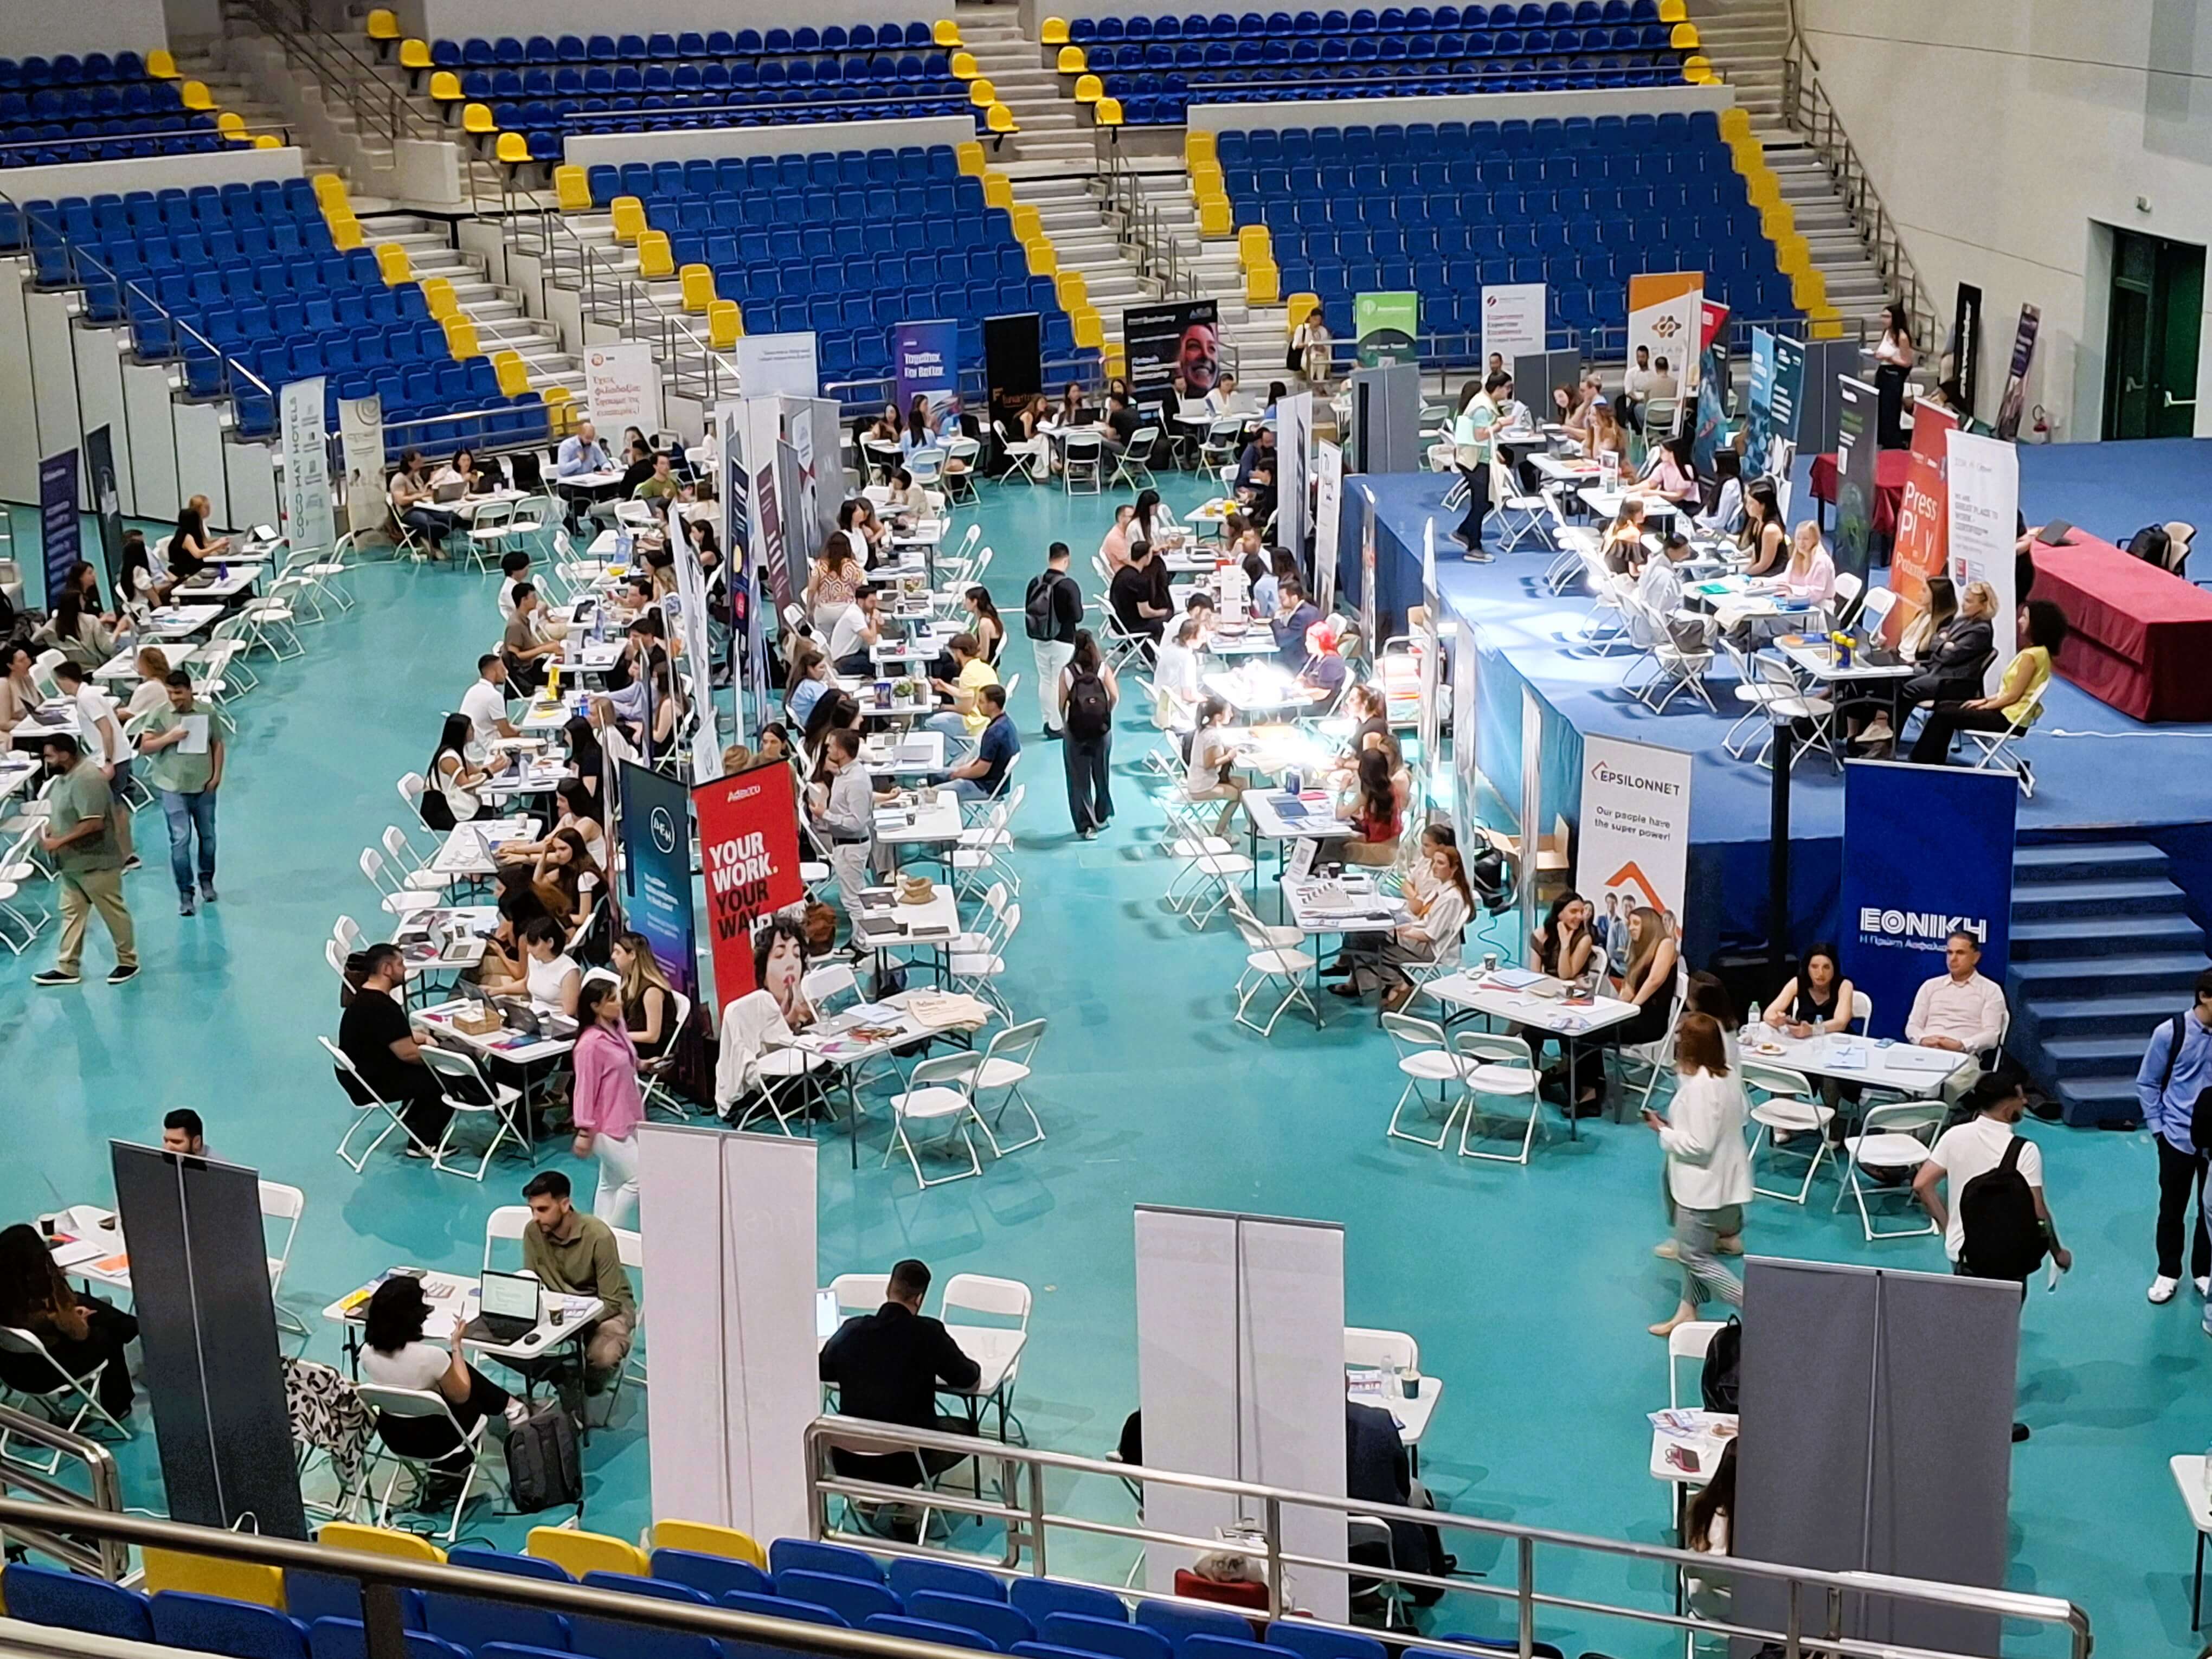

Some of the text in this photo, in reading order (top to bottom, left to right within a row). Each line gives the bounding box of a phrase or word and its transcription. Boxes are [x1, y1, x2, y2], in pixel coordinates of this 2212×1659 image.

[290, 396, 305, 538] COCO-MAT HOTELS
[1904, 480, 1938, 521] Press
[1600, 770, 1680, 796] EPSILONNET
[1594, 818, 1671, 841] the super power!
[1597, 806, 1671, 829] Our people have
[709, 831, 764, 869] YOUR
[712, 852, 779, 893] WORK.
[716, 879, 770, 916] YOUR
[717, 905, 761, 941] WAY
